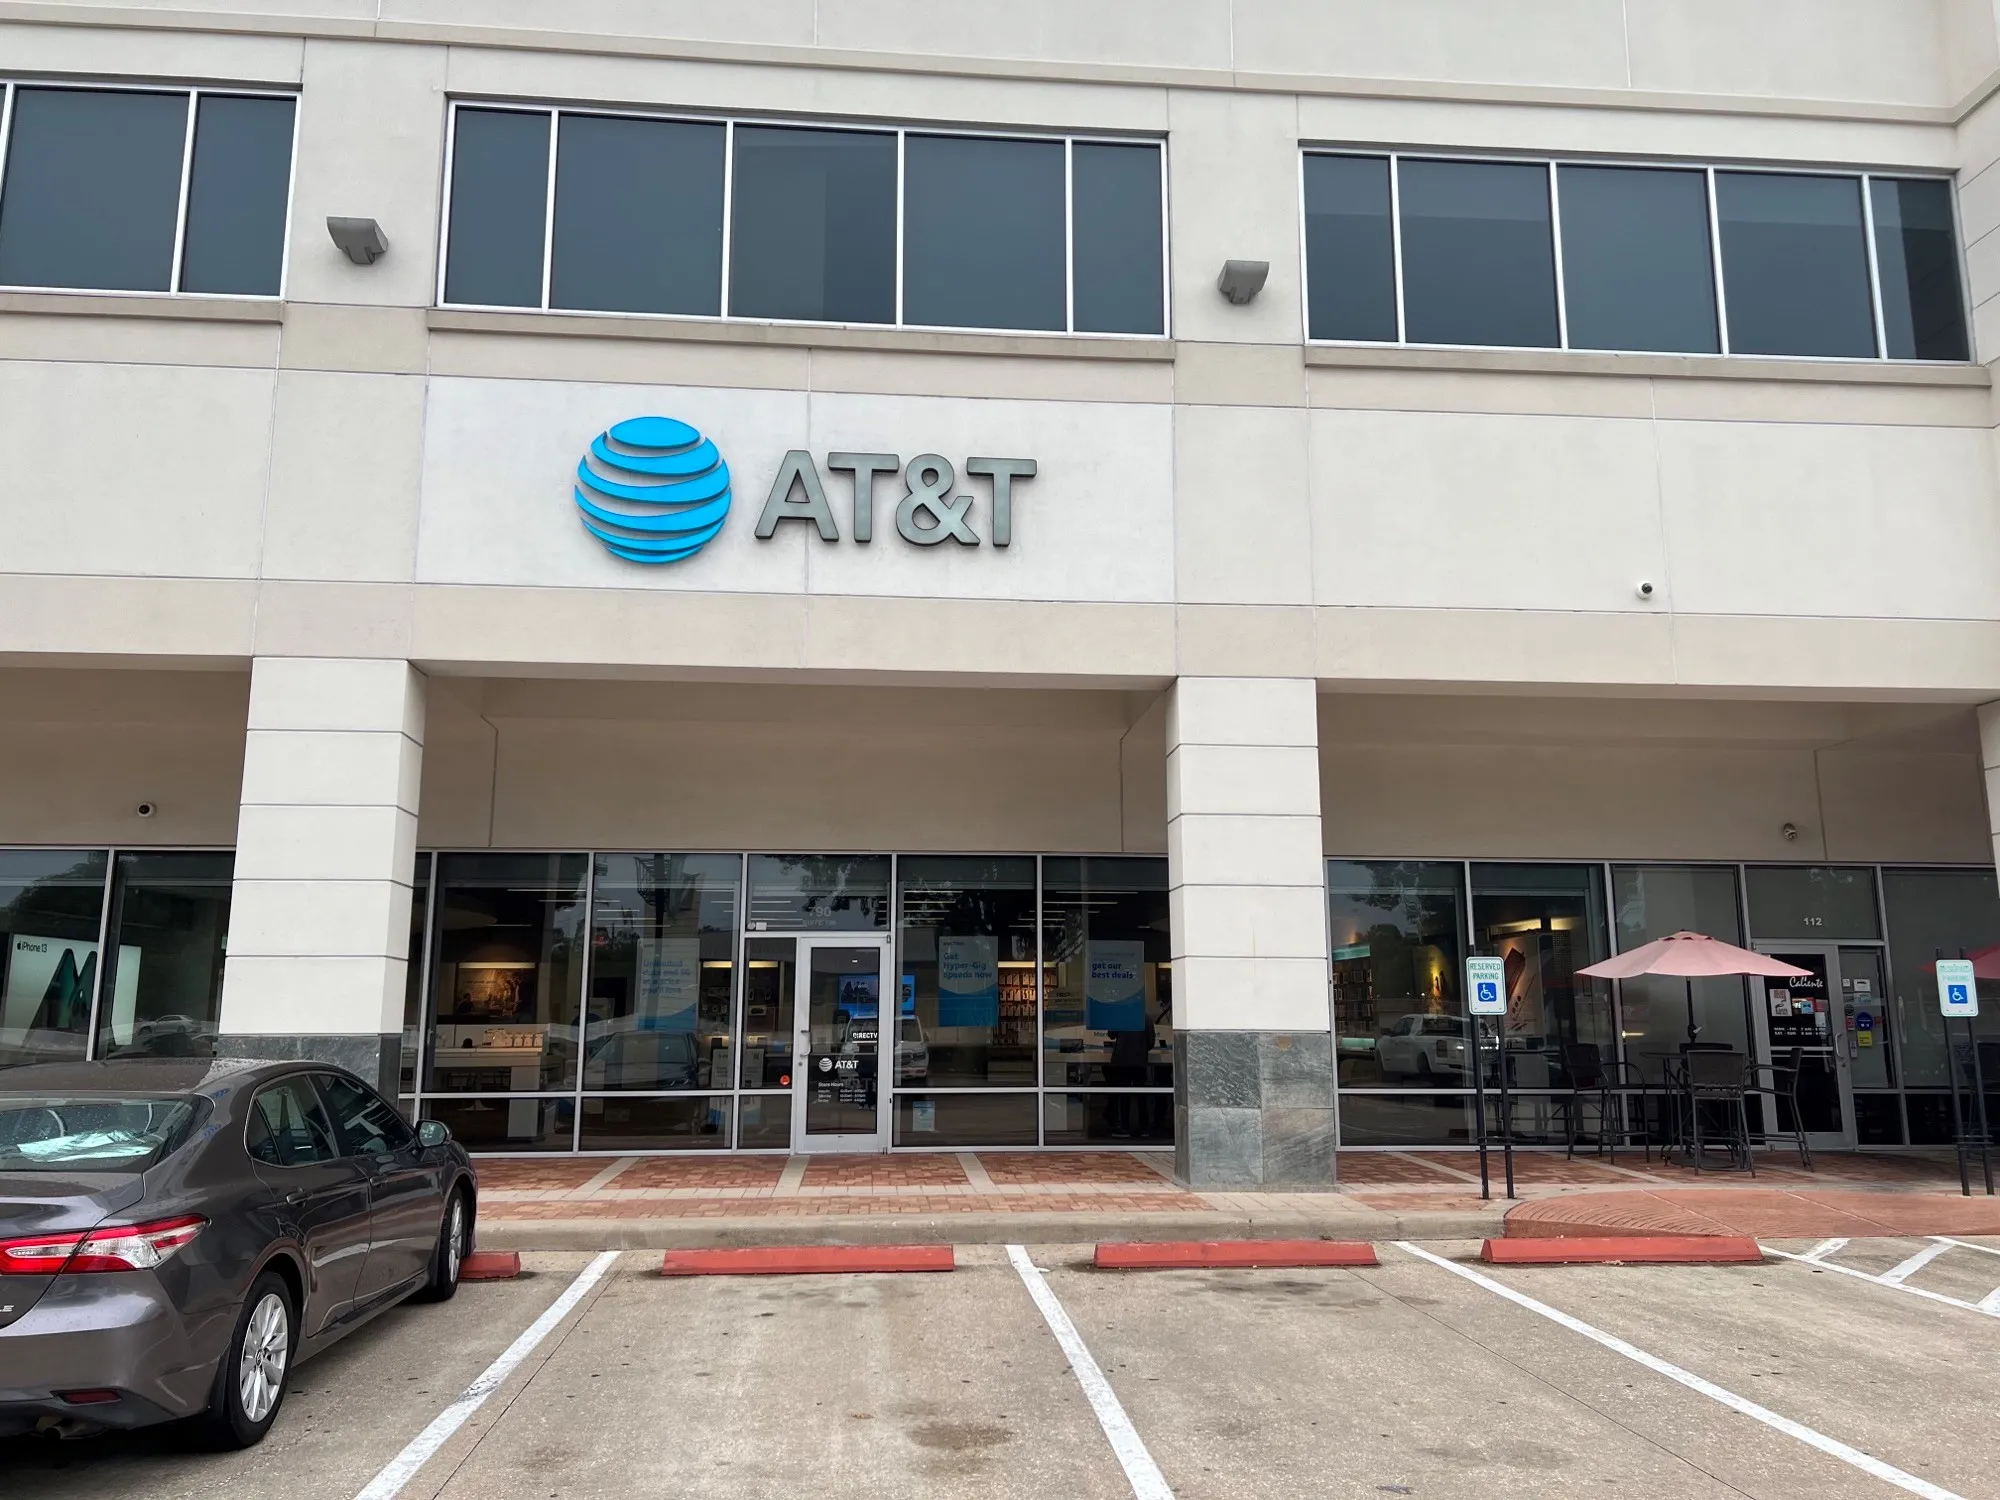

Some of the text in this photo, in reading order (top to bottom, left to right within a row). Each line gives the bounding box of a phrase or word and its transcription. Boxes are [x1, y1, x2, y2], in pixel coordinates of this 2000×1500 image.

[754, 449, 1038, 547] AT&T
[808, 906, 832, 917] 790
[1803, 917, 1823, 926] 112
[22, 941, 48, 953] iPhone 13
[943, 952, 959, 960] Get
[943, 961, 987, 971] Hyper-Gig
[1091, 962, 1122, 971] get our
[1470, 963, 1501, 971] RESERVED
[943, 971, 993, 980] speeds now
[1091, 971, 1134, 979] best deals
[1472, 972, 1499, 980] PARKING
[1789, 976, 1824, 988] Caliente
[834, 1060, 859, 1069] AT&T
[0, 1304, 15, 1313] E
